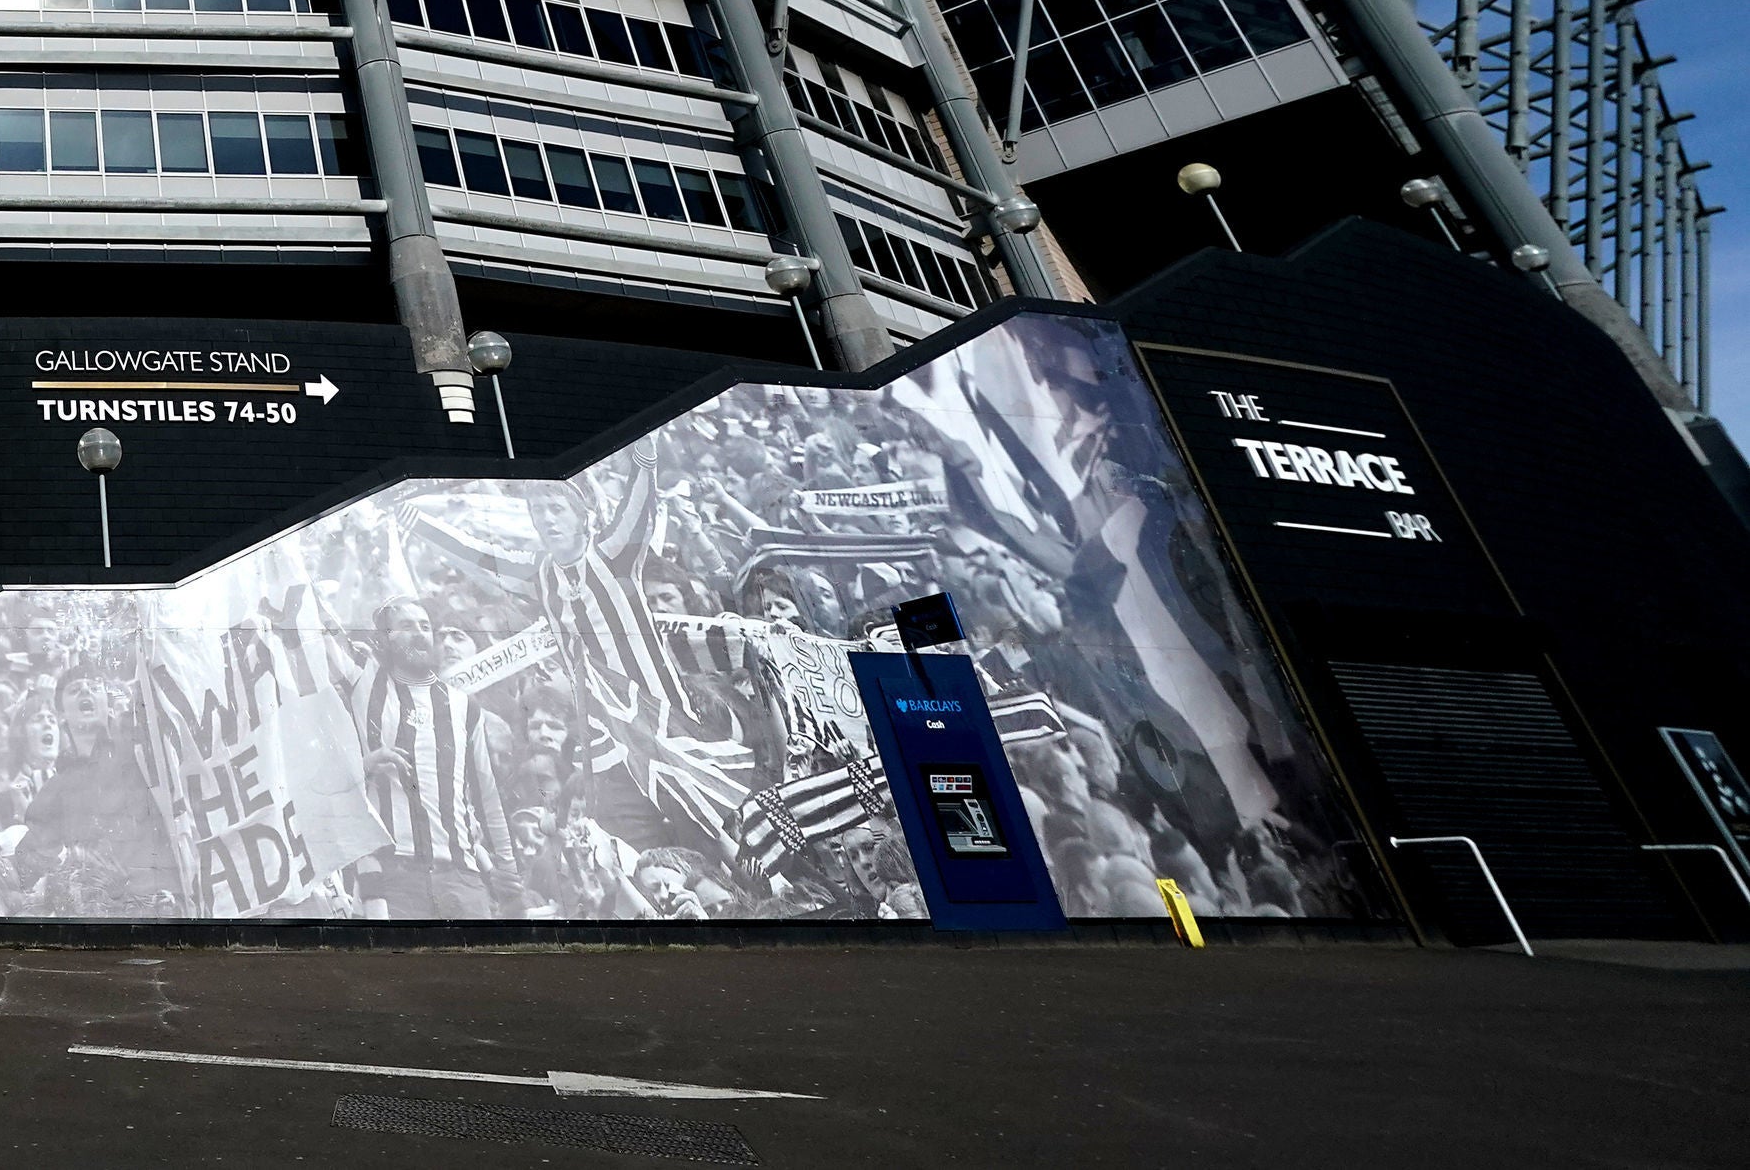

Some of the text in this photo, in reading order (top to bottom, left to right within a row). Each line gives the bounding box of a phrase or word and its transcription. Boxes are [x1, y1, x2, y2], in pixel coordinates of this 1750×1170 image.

[35, 350, 291, 374] GALLOWGATE STAND
[37, 399, 297, 424] TURNSTILES 74-50
[1207, 390, 1270, 422] THE
[1231, 437, 1416, 495] TERRACE
[815, 491, 908, 508] NEWCASTLE
[1384, 511, 1444, 543] BAR
[908, 699, 962, 712] BARCLAYS
[926, 720, 945, 729] Cash
